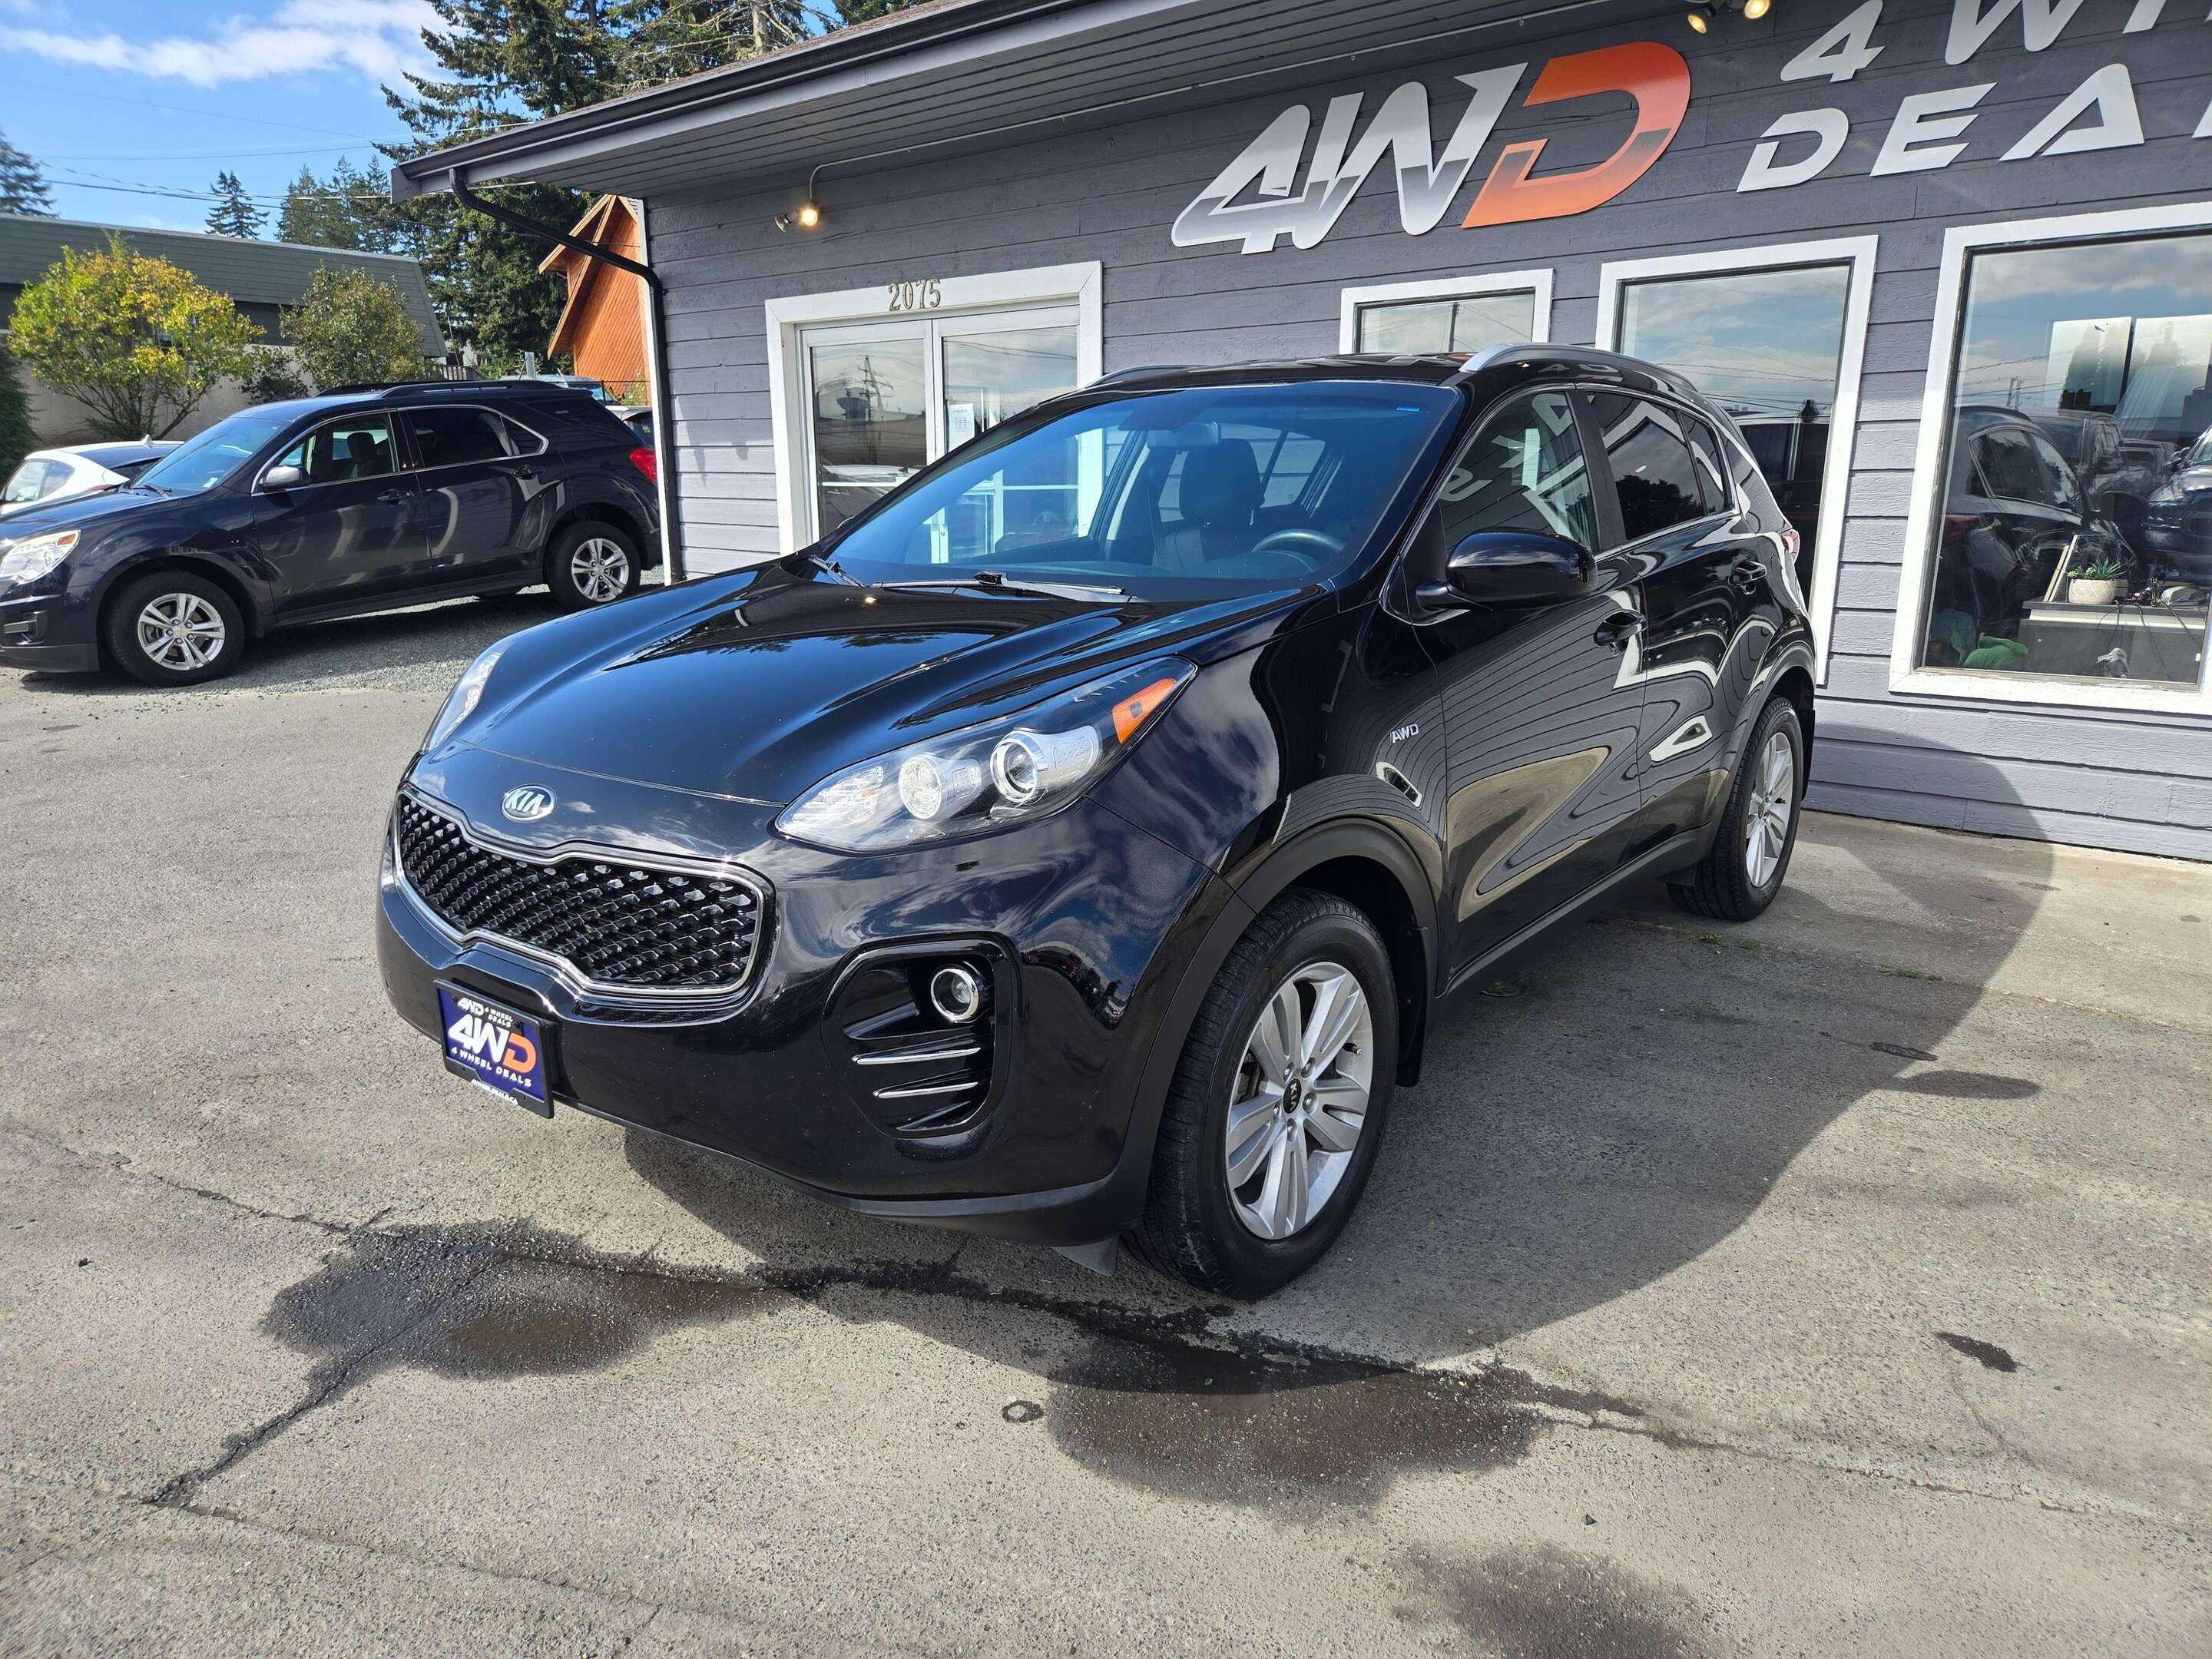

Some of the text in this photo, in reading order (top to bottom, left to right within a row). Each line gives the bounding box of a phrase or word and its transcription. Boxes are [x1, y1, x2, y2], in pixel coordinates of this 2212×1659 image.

[1780, 0, 1886, 82] 4
[1736, 63, 2212, 192] DEA
[1171, 41, 1691, 254] 4WD
[888, 278, 941, 311] 2075
[1390, 723, 1419, 743] AWD
[505, 789, 545, 815] KIA
[488, 1014, 512, 1028] DEALS
[490, 1008, 514, 1022] WHEEL
[448, 1014, 536, 1073] 4WD
[451, 1046, 532, 1088] 4 WHEEL DEALS
